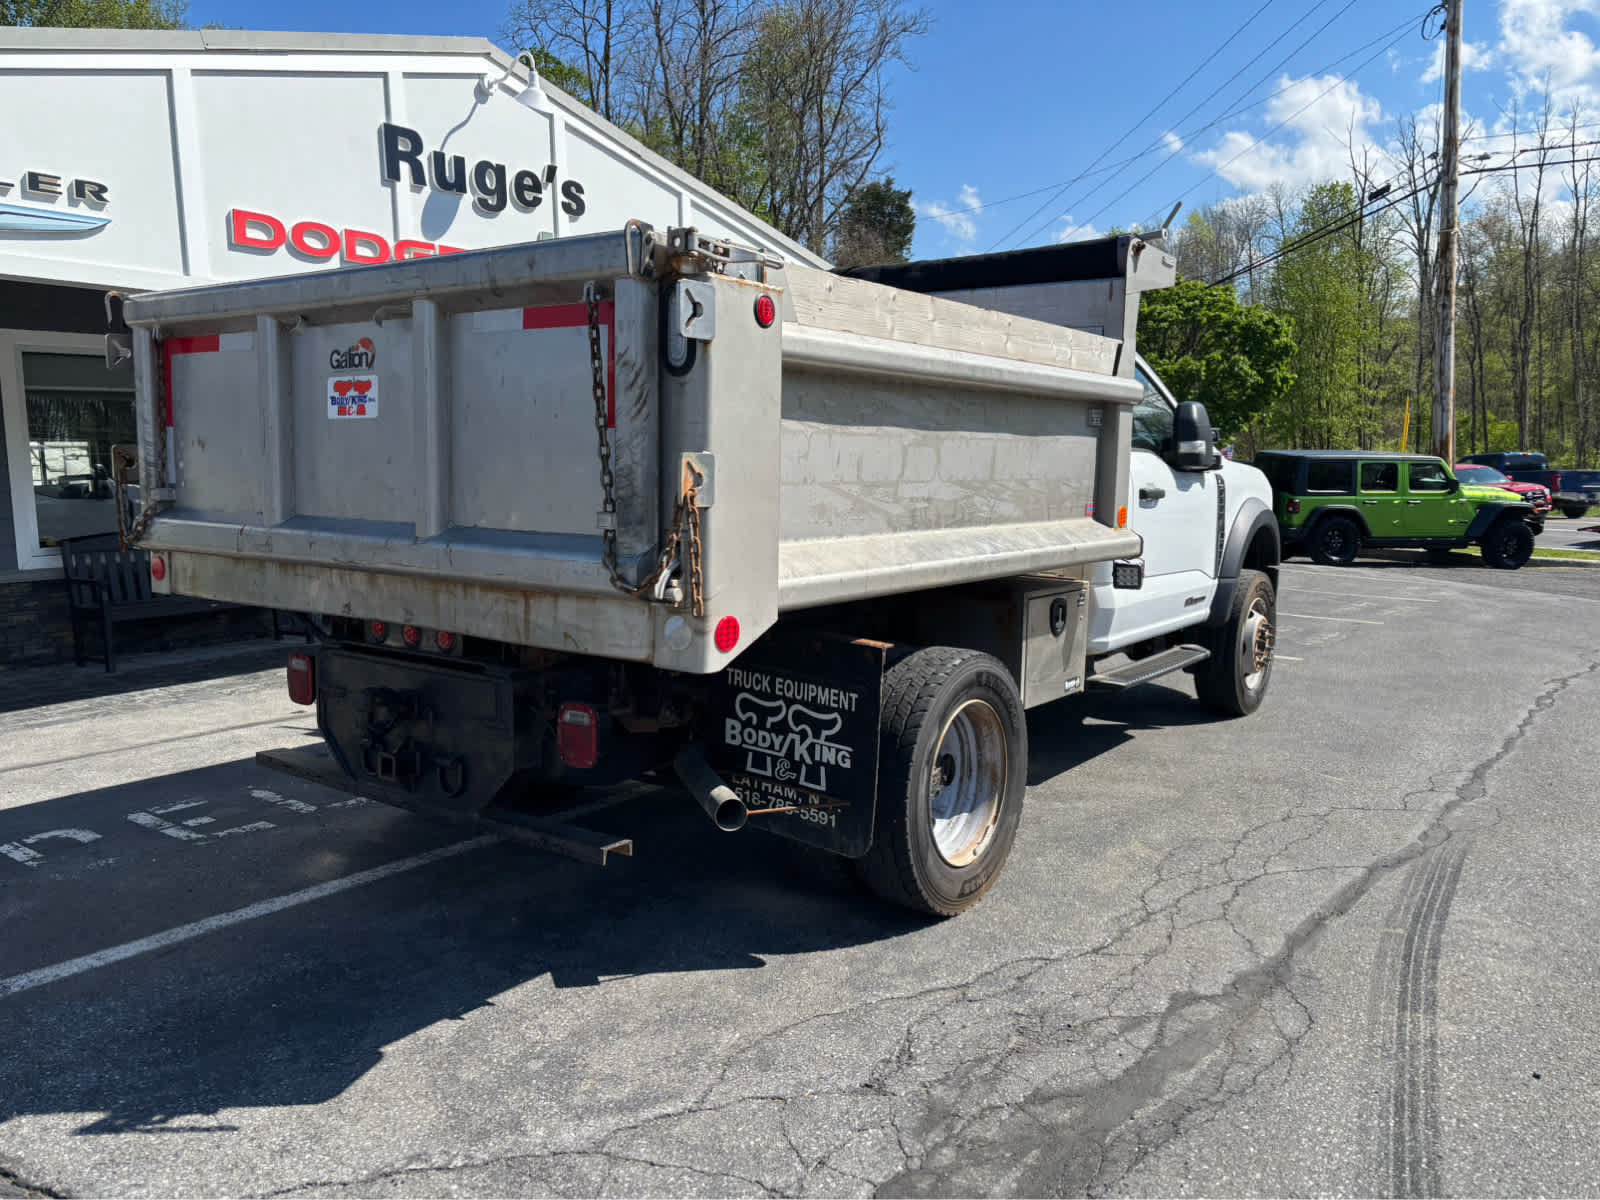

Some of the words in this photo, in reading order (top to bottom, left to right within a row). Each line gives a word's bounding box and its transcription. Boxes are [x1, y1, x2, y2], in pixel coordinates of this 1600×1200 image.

[381, 123, 586, 217] Ruge's
[231, 208, 468, 264] DODG
[726, 668, 771, 693] TRUCK
[775, 677, 859, 712] EQUIPMENT
